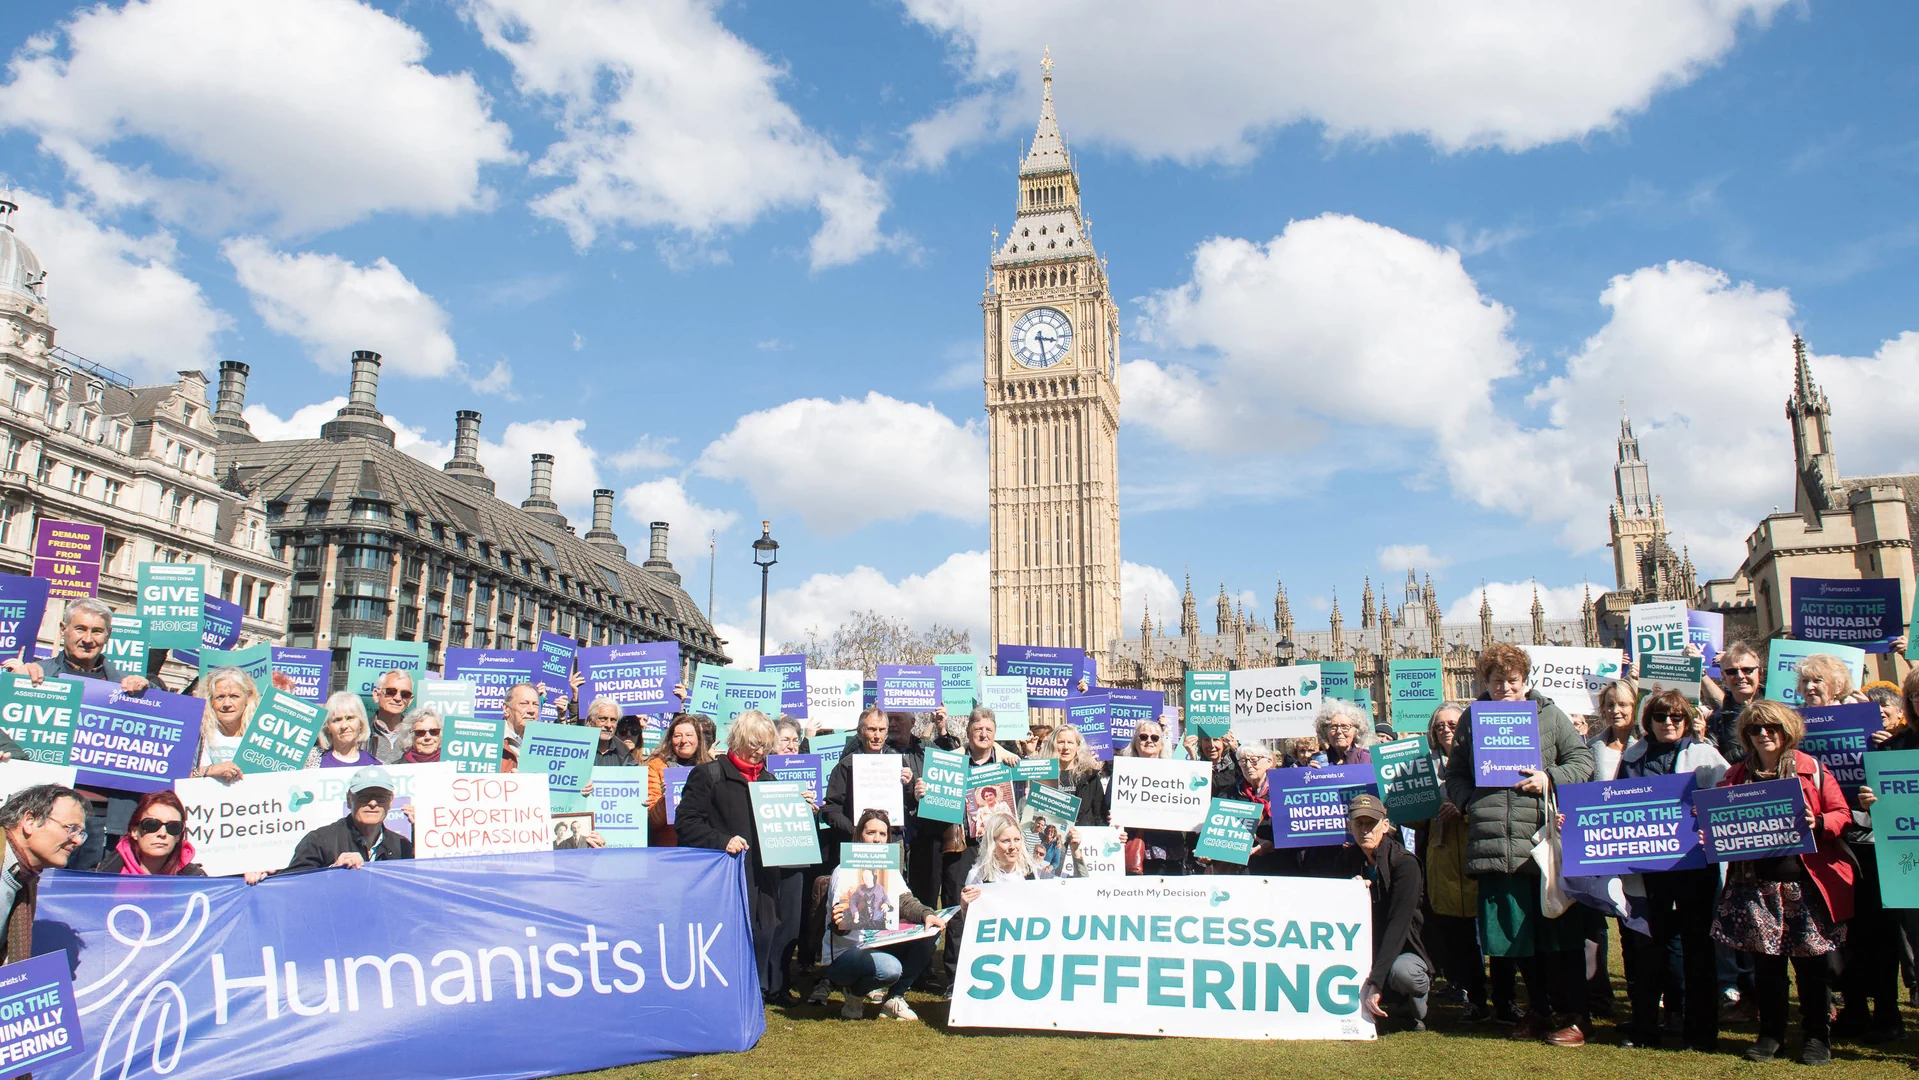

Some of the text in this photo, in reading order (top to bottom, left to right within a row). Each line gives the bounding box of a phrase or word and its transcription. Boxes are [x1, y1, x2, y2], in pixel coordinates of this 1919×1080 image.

[52, 530, 90, 540] DEMAND
[48, 540, 91, 550] FREEDOM
[56, 551, 81, 559] FROM
[53, 564, 81, 575] UN-
[51, 579, 91, 589] EATABLE
[144, 585, 199, 602] GIVE
[143, 605, 166, 615] ME
[169, 605, 199, 616] THE
[1801, 603, 1886, 614] ACT FOR THE
[1637, 622, 1682, 633] HOW WE
[1804, 616, 1882, 627] INCURABLY
[213, 622, 232, 636] THE
[1804, 628, 1883, 640] SUFFERING
[1638, 631, 1684, 653] DIE
[542, 645, 571, 658] FREEDOM
[357, 657, 419, 671] FREEDOM
[550, 655, 560, 663] OF
[114, 660, 142, 672] THE
[281, 666, 320, 677] FOR THE
[590, 665, 667, 680] ACT FOR THE
[1007, 666, 1073, 677] ACT FOR THE
[1544, 663, 1590, 675] Death
[1647, 664, 1673, 672] NORMAN
[457, 673, 531, 684] ACT FOR THE
[1396, 672, 1436, 680] FREEDOM
[595, 678, 664, 692] INCURABLY
[14, 690, 46, 699] ASSISTED
[725, 688, 777, 699] FREEDOM
[884, 689, 935, 697] TERMINALLY
[1190, 689, 1229, 701] GIVE
[1235, 687, 1296, 699] My Death
[1399, 689, 1435, 697] CHOICE
[119, 695, 152, 706] Humanists
[744, 701, 759, 710] OF
[884, 698, 936, 706] SUFFERING
[2, 703, 72, 727] GIVE
[272, 704, 312, 723] ASSISTED DYING
[1071, 707, 1105, 717] FREEDOM
[1111, 708, 1152, 719] FOR THE
[1190, 704, 1230, 713] ME THE
[1235, 701, 1312, 716] My Decision
[1084, 716, 1094, 724] OF
[1190, 716, 1230, 725] CHOICE
[1479, 716, 1532, 725] FREEDOM
[110, 717, 182, 741] FOR THE
[258, 713, 313, 747] GIVE
[1498, 726, 1513, 736] OF
[31, 729, 68, 745] THE
[73, 729, 174, 757] INCURABLY
[1483, 736, 1530, 745] CHOICE
[1830, 736, 1866, 749] THE
[249, 732, 305, 762] ME THE
[447, 740, 498, 758] GIVE
[529, 744, 589, 759] FREEDOM
[70, 747, 169, 774] SUFFERING
[1383, 752, 1405, 760] ASSISTED
[469, 761, 496, 773] THE
[549, 760, 566, 771] OF
[1381, 758, 1430, 780] GIVE
[1490, 763, 1525, 771] Humanists
[774, 771, 816, 779] ACT FOR THE
[927, 767, 964, 786] GIVE
[1119, 775, 1185, 789] My Death
[1384, 776, 1433, 794] ME THE
[452, 778, 518, 802] STOP
[925, 782, 963, 797] ME THE
[1610, 788, 1642, 796] Humanists
[924, 794, 961, 810] CHOICE
[1031, 792, 1047, 801] KEVAN
[1117, 790, 1201, 805] My Decision
[1284, 792, 1338, 806] ACT FOR
[1387, 790, 1436, 808] CHOICE
[185, 799, 282, 823] My Death
[601, 801, 617, 810] OF
[759, 802, 808, 819] GIVE
[433, 806, 543, 828] EXPORTING
[1577, 806, 1683, 827] ACT FOR THE
[1710, 803, 1793, 823] ACT FOR THE
[762, 820, 812, 833] ME THE
[1211, 813, 1255, 830] GIVE
[1712, 816, 1796, 838] INCURABLY
[185, 819, 305, 843] My Decision
[424, 827, 549, 848] COMPASSION!
[1207, 826, 1251, 841] ME THE
[1584, 823, 1679, 842] INCURABLY
[765, 836, 814, 848] CHOICE
[1204, 837, 1249, 851] CHOICE
[1714, 831, 1801, 852] SUFFERING
[1585, 839, 1680, 858] SUFFERING
[1097, 887, 1206, 899] My Death My Decision
[975, 915, 1362, 951] END UNNECESSARY
[210, 922, 729, 1025] Humanists UK
[967, 954, 1360, 1015] SUFFERING
[25, 989, 61, 1012] THE
